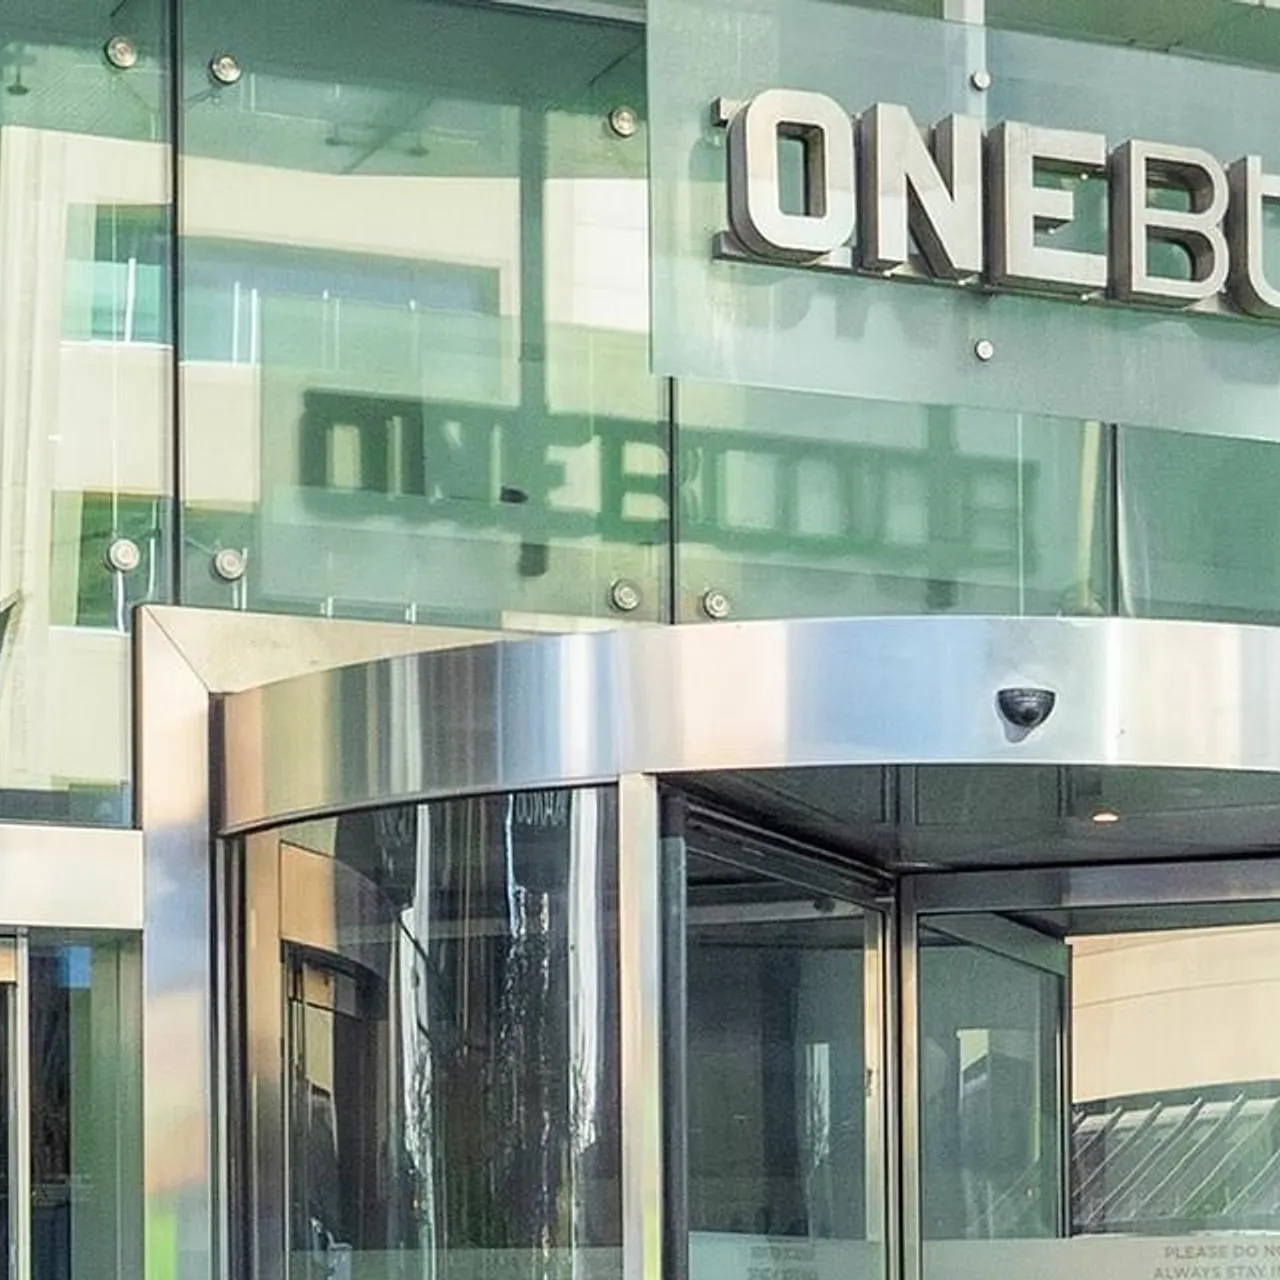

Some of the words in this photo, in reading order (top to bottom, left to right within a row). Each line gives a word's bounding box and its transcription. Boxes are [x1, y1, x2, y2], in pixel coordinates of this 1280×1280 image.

[1165, 1244, 1227, 1259] PLEASE
[1233, 1244, 1258, 1258] DO
[1154, 1266, 1220, 1280] ALWAYS
[1226, 1265, 1266, 1279] STAY
